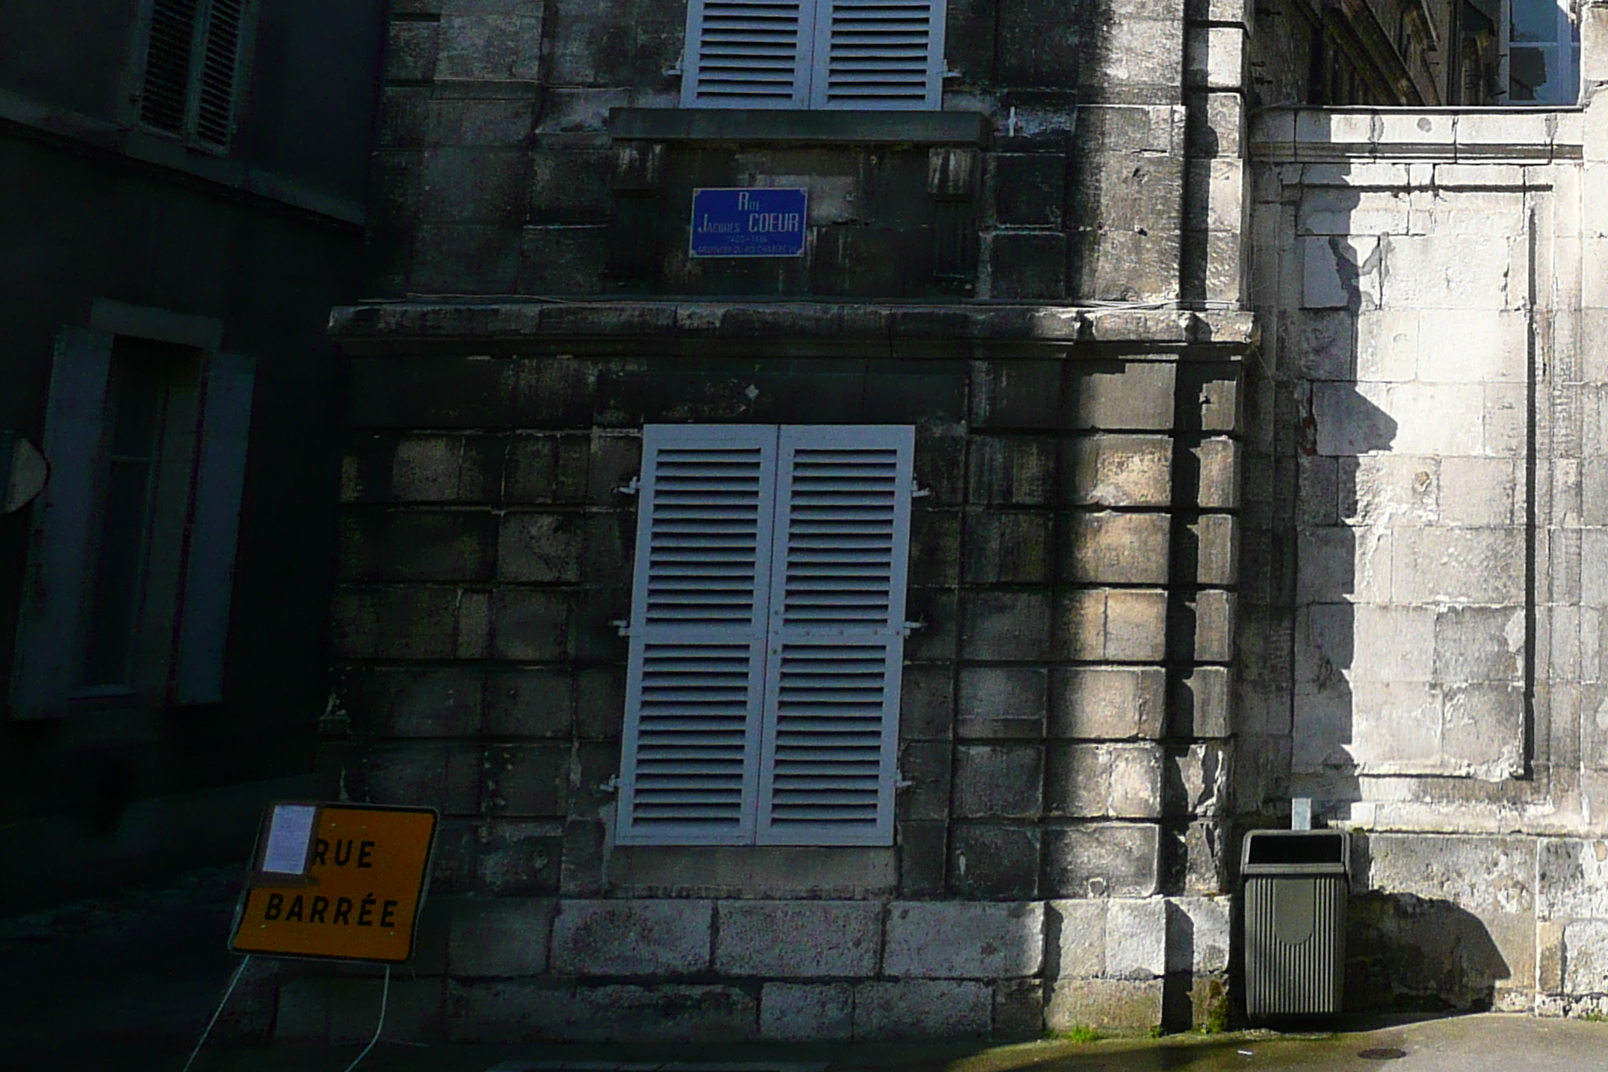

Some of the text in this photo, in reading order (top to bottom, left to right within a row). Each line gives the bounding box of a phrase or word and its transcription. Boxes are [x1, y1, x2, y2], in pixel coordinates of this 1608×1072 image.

[748, 212, 799, 233] COEUR
[312, 837, 376, 869] RUE
[263, 891, 399, 929] BARRÉE
